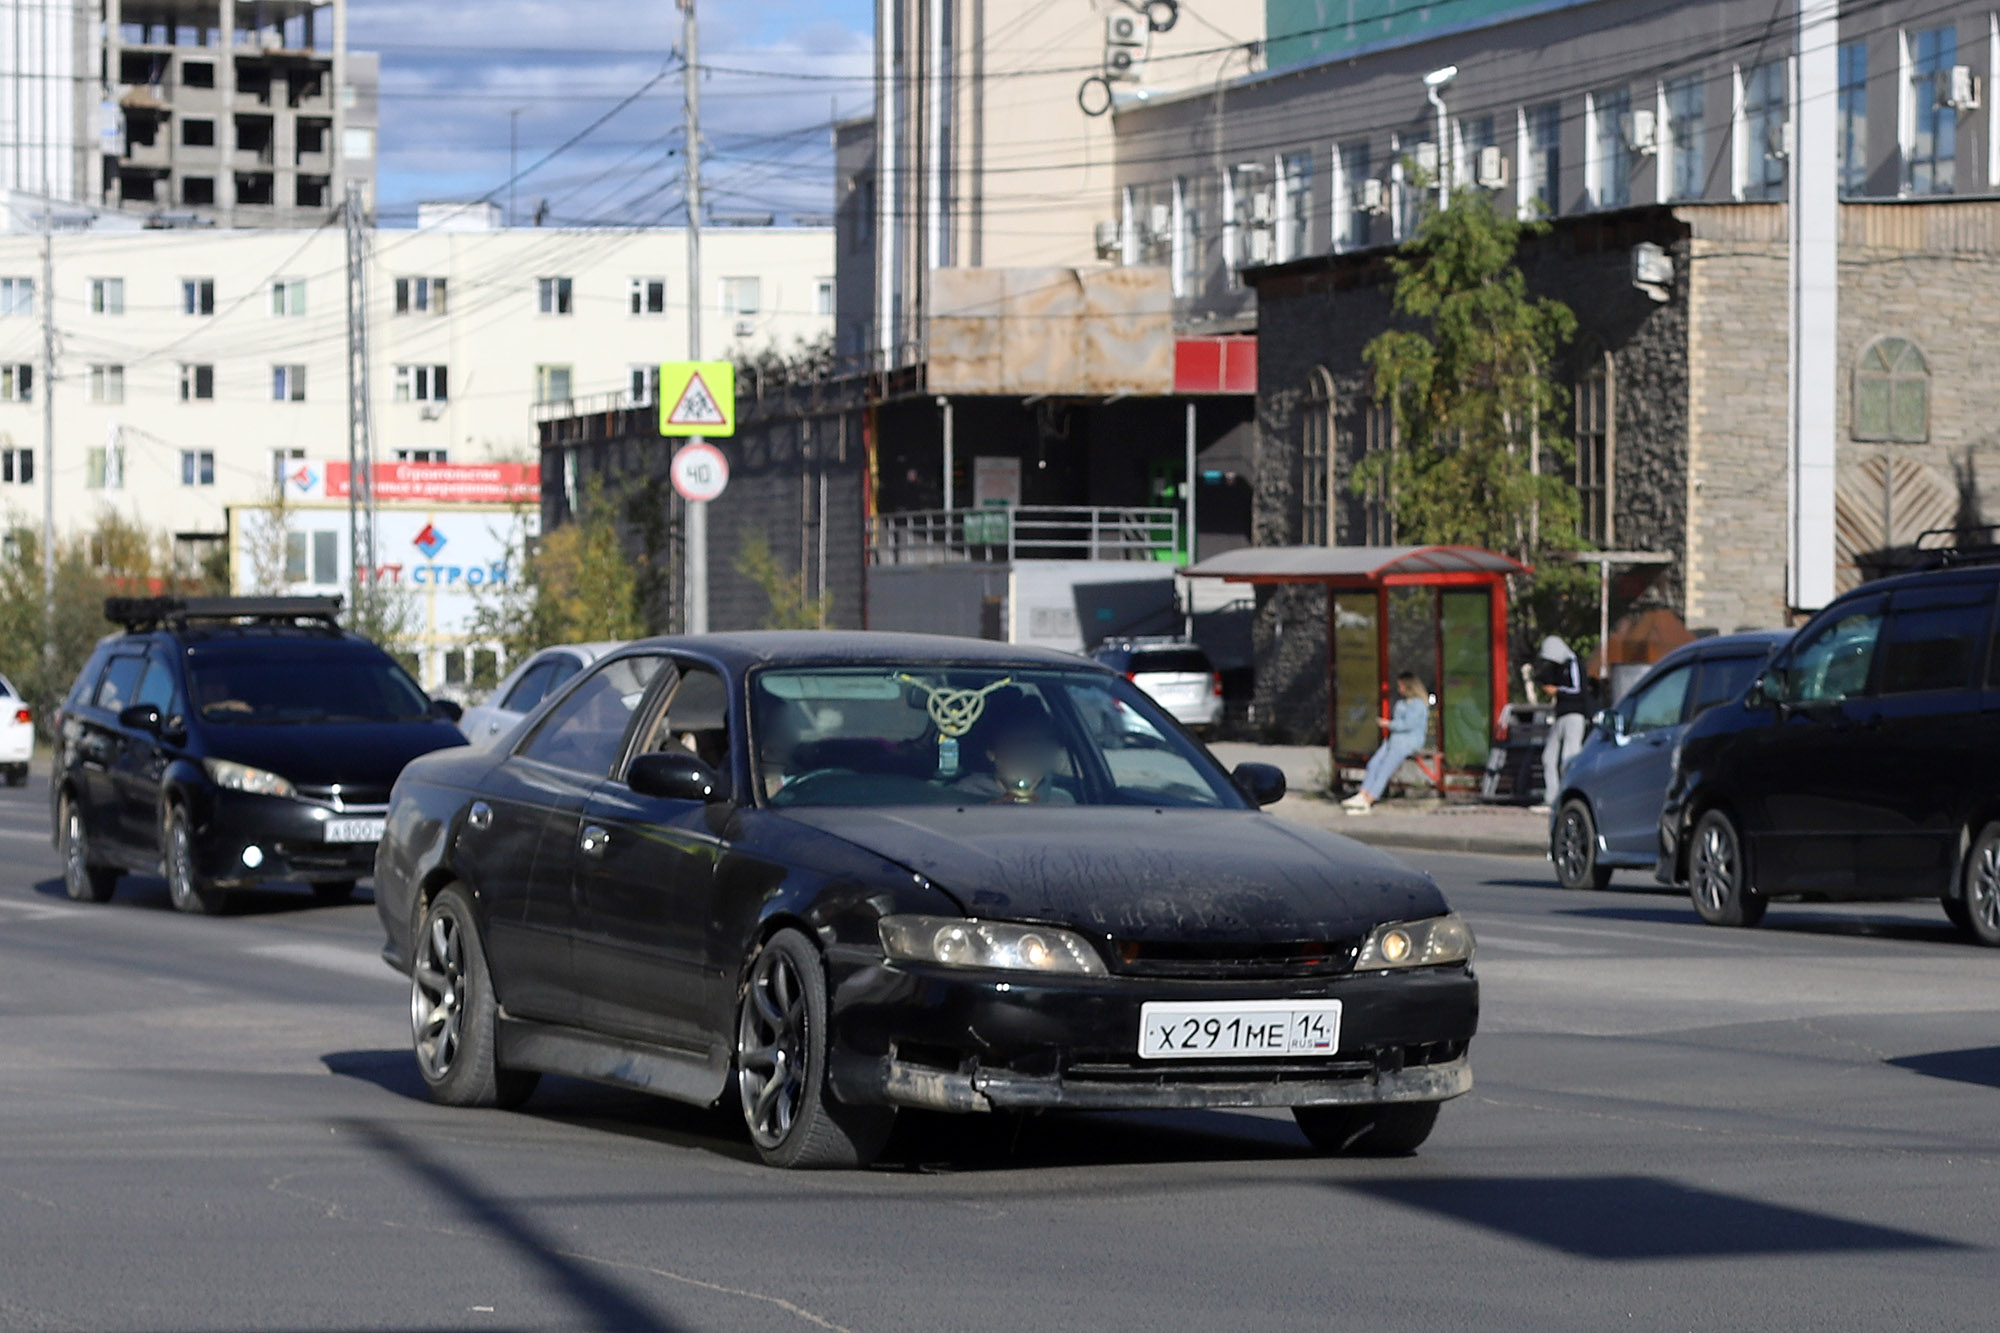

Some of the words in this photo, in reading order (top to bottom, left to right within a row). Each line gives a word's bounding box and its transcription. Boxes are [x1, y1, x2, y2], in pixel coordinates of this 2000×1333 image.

[686, 463, 711, 484] 40
[412, 560, 509, 586] СТРОЙ
[1158, 1018, 1284, 1050] Х291МЕ
[1297, 1014, 1325, 1039] 14
[1291, 1038, 1314, 1049] RUS
